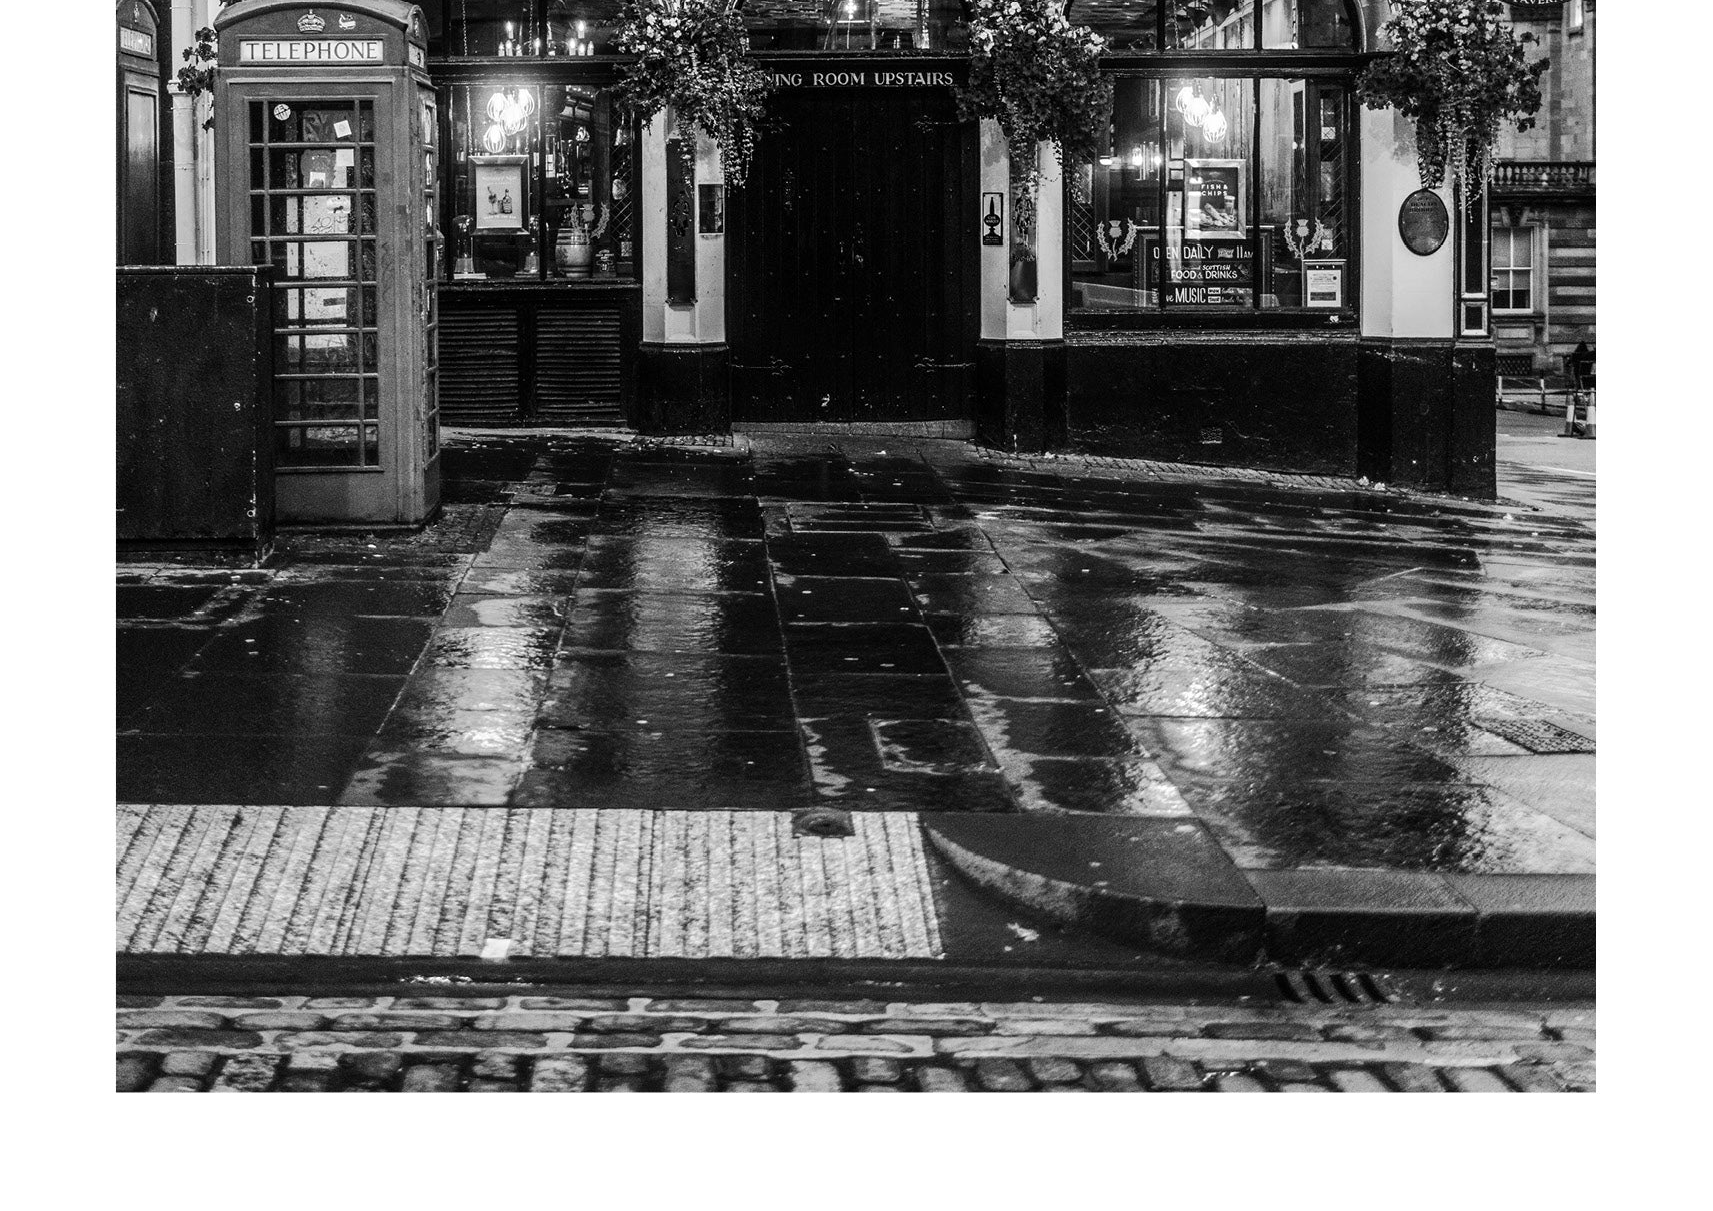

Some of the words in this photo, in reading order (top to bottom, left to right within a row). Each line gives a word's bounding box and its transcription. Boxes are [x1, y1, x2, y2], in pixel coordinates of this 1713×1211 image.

[246, 42, 378, 60] TELEPHONE
[813, 72, 865, 86] ROOM
[874, 72, 953, 86] UPSTAIRS
[1153, 246, 1178, 259] OEN
[1183, 245, 1214, 259] DAILY
[1171, 270, 1197, 279] FOOD
[1205, 270, 1238, 279] DRINKS
[1175, 287, 1206, 303] MUSIC
